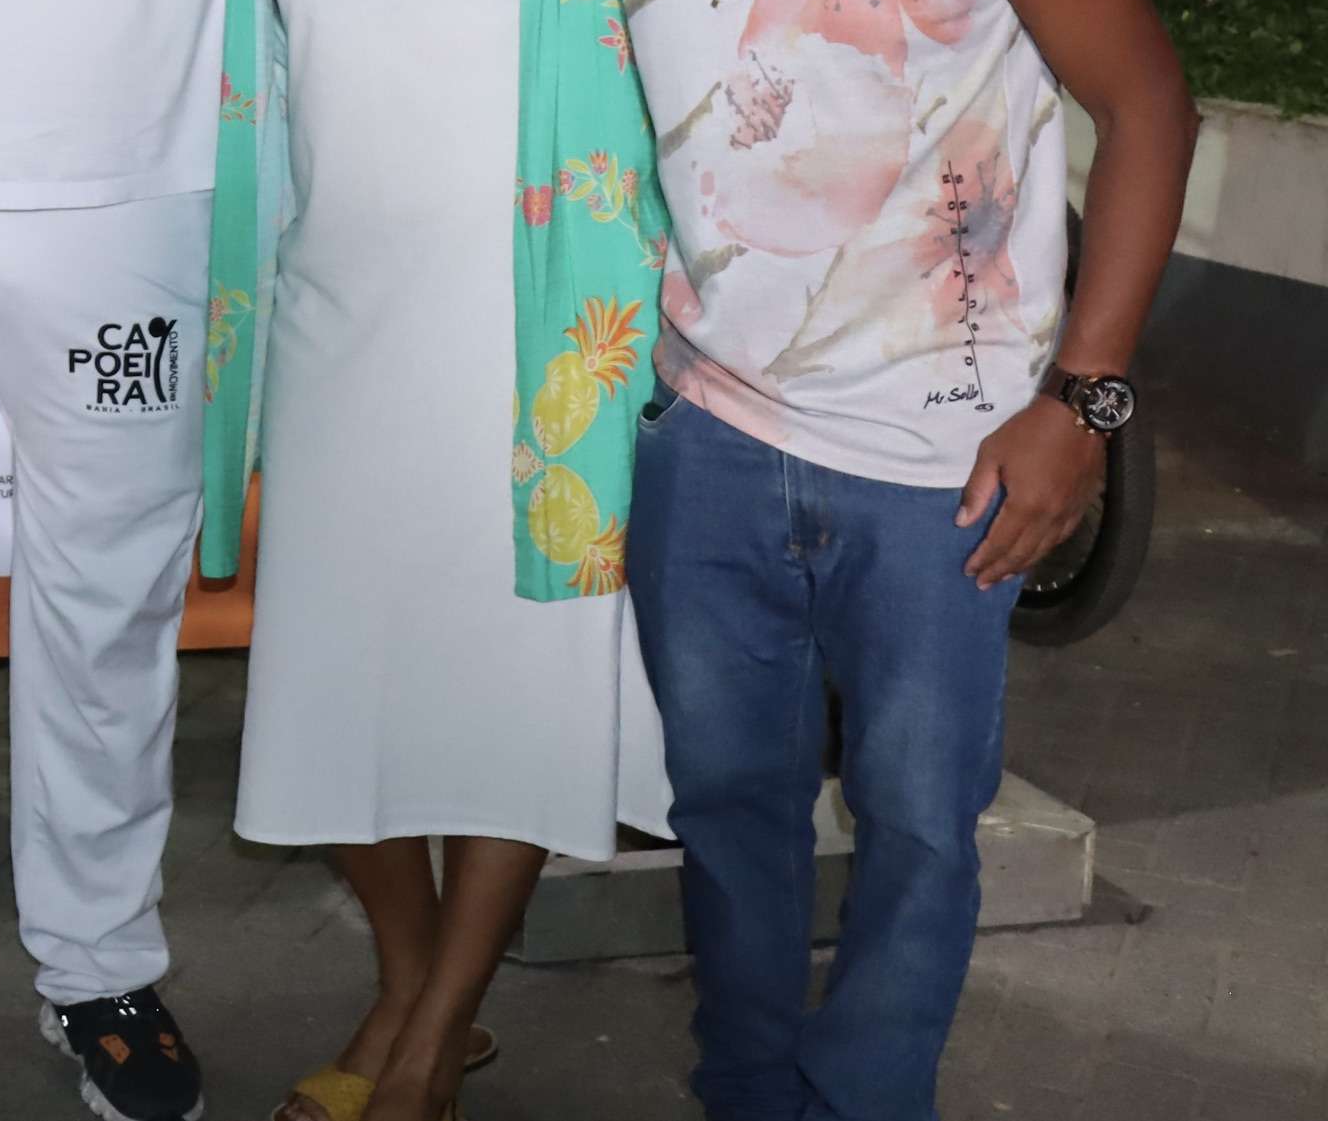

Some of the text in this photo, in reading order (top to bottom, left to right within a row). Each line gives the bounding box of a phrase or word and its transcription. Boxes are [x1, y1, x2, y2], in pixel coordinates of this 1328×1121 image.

[97, 322, 149, 351] CA
[68, 348, 152, 378] POEI
[168, 330, 179, 391] MOVIMENTO
[96, 378, 148, 406] RA
